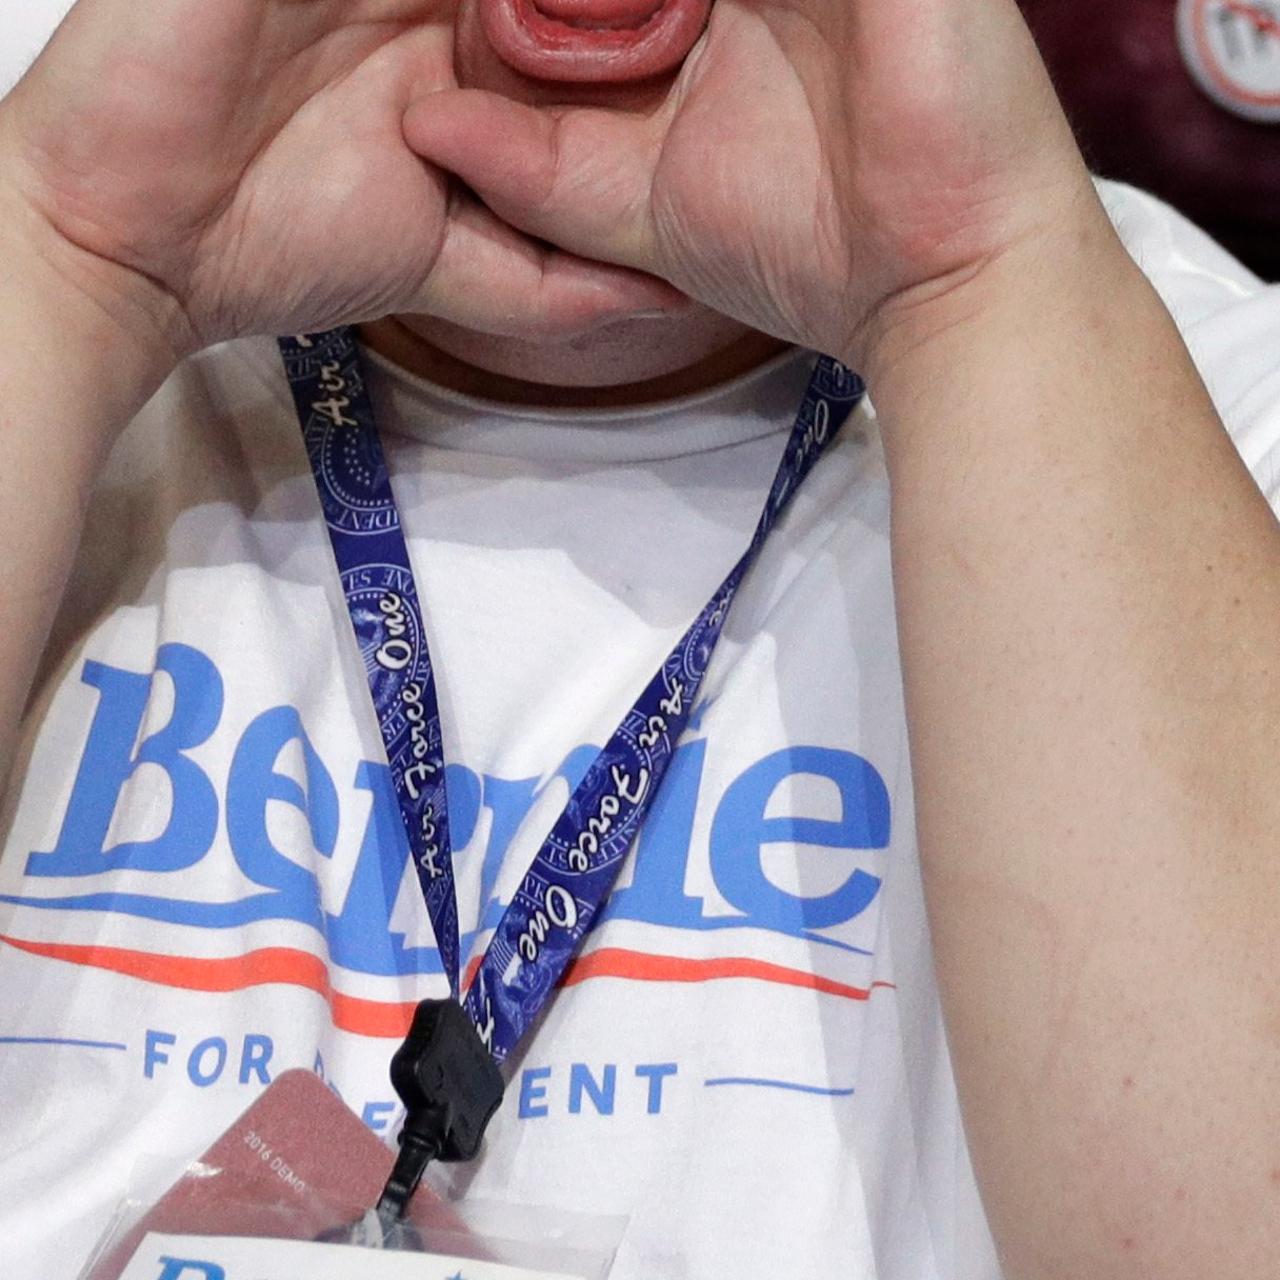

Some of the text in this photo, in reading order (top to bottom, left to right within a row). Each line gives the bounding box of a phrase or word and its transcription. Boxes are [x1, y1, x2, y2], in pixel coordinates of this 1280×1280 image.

[310, 360, 359, 427] Air
[375, 592, 413, 670] One
[402, 682, 438, 800] Force
[639, 677, 684, 749] Air
[420, 805, 443, 879] Air
[569, 765, 650, 873] Force
[518, 885, 579, 962] One
[142, 1028, 275, 1088] FOR
[242, 1129, 273, 1163] 2016
